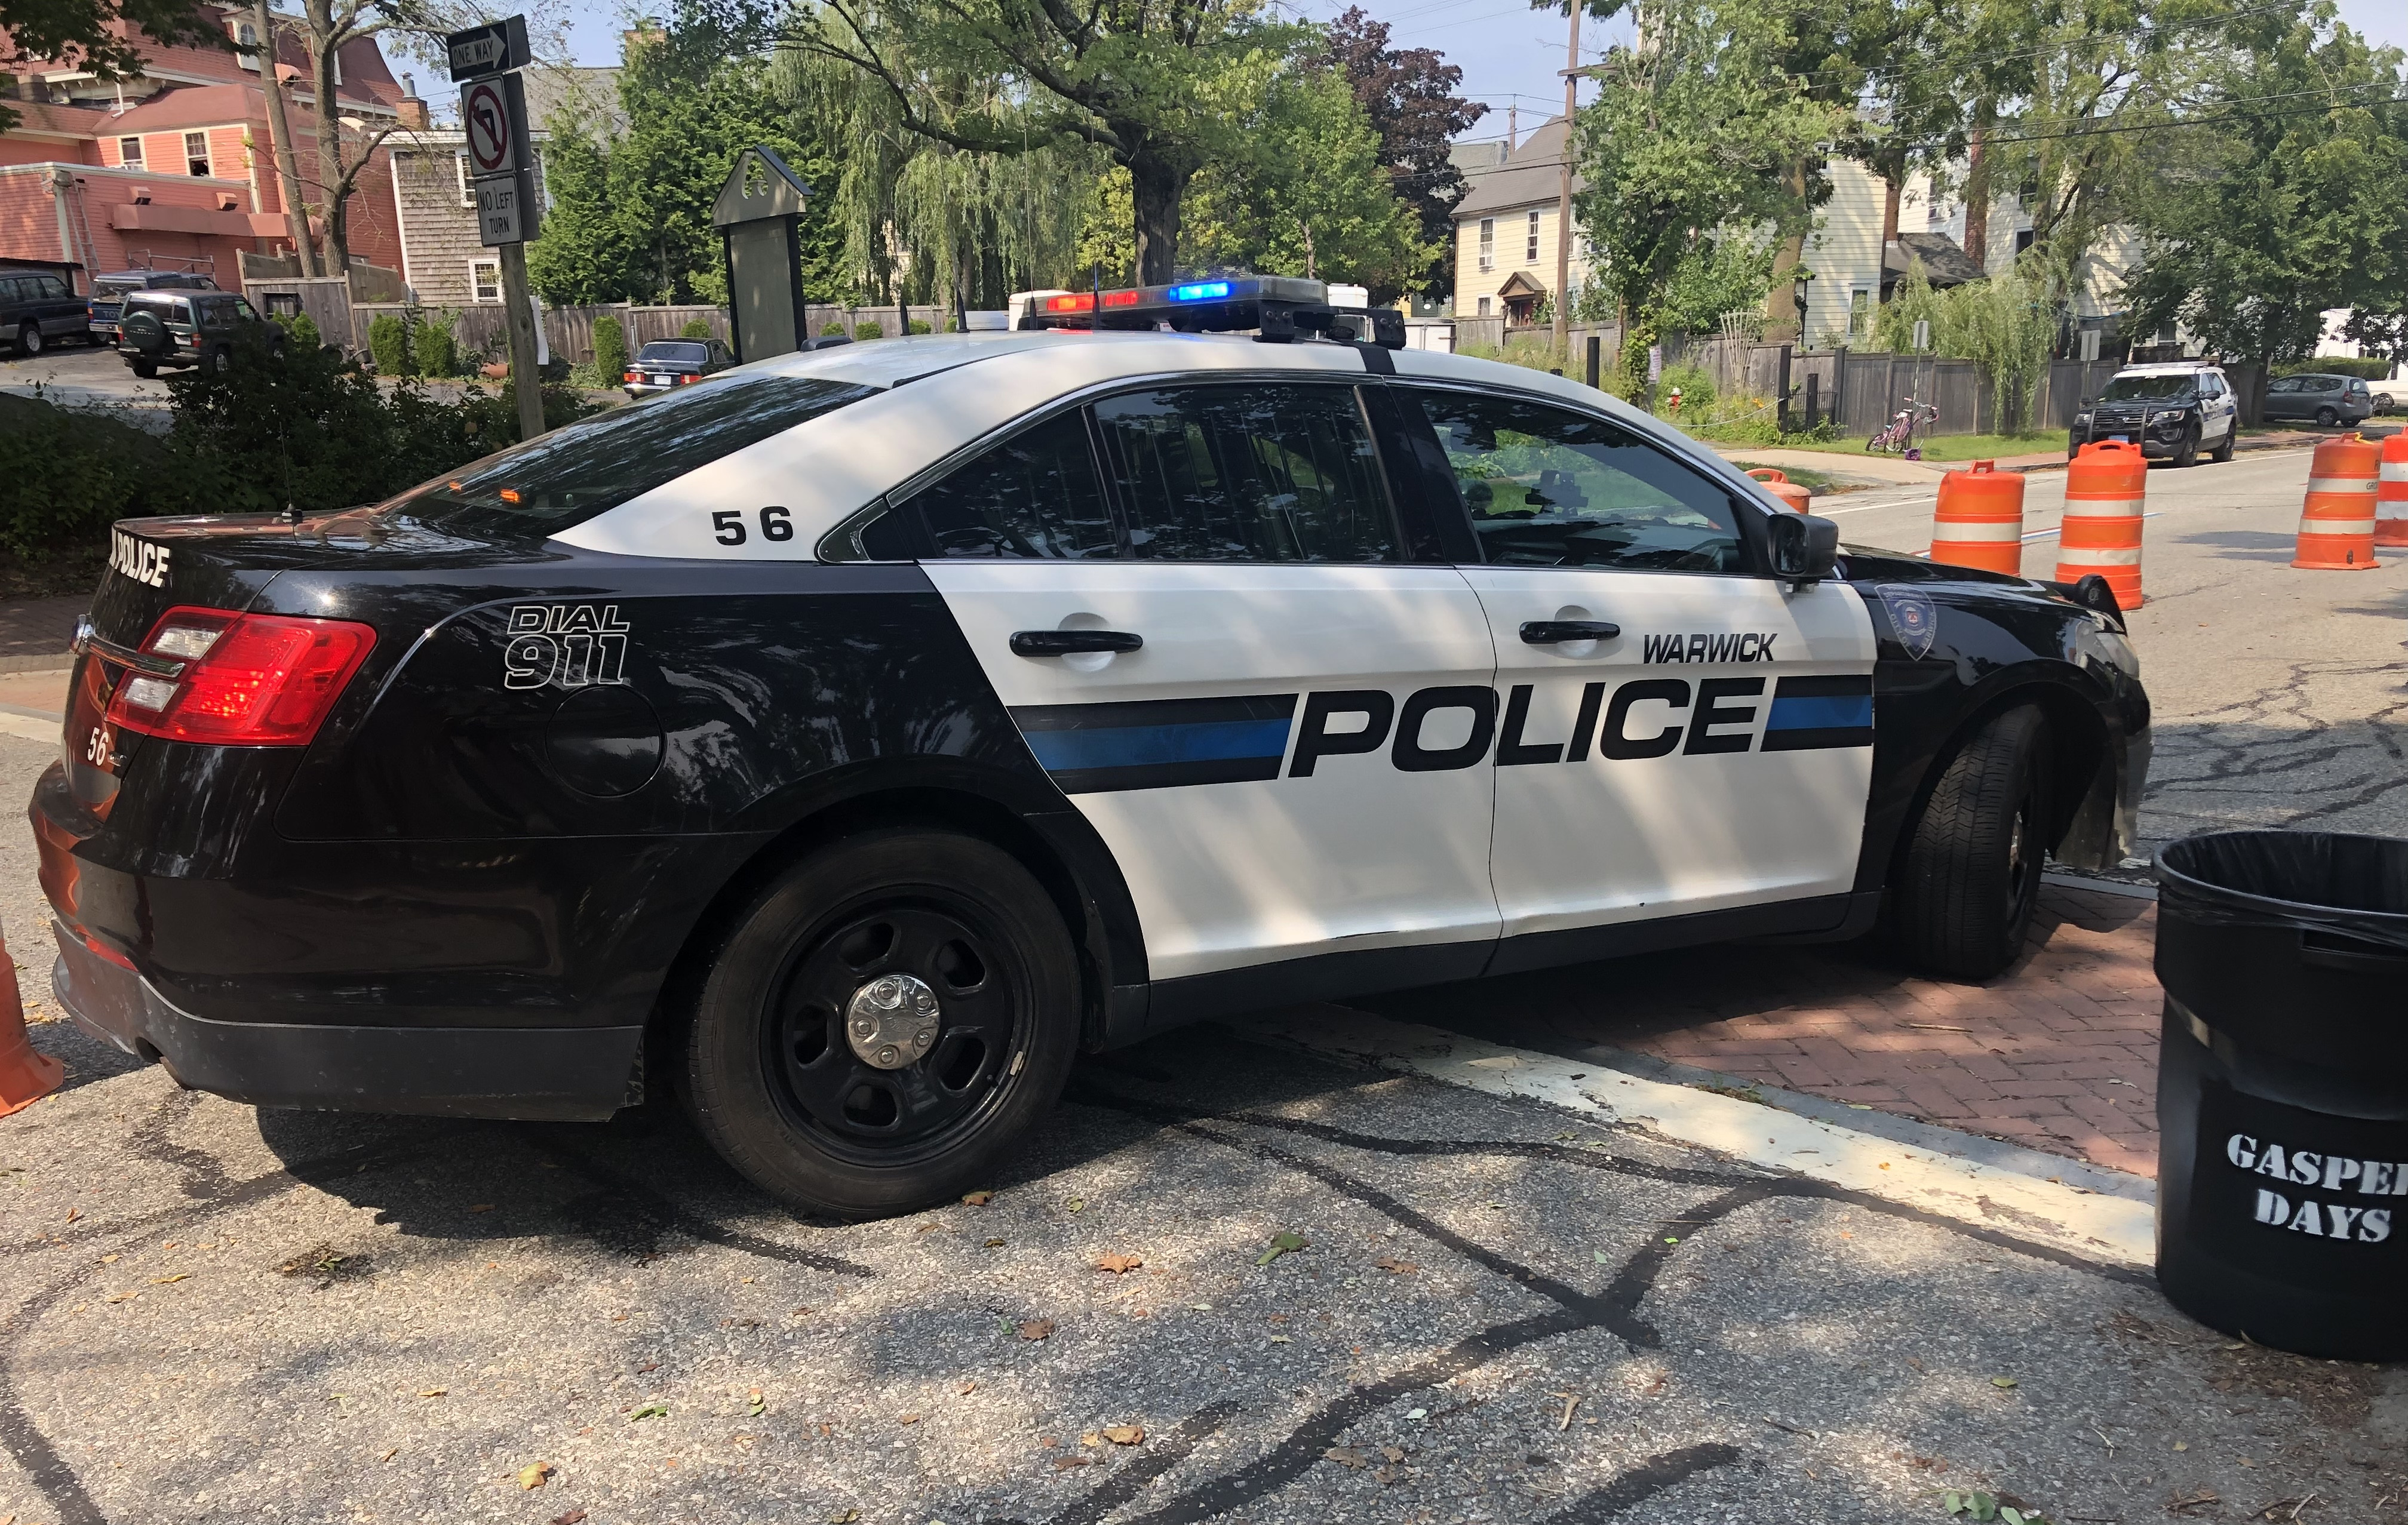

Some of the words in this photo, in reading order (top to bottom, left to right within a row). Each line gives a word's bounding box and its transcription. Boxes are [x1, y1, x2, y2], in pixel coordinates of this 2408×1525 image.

[453, 45, 471, 65] ONE
[474, 40, 493, 61] WAY
[479, 191, 493, 212] NO
[494, 191, 513, 210] LEFT
[489, 216, 509, 234] TURN
[114, 531, 170, 588] POLICE
[507, 605, 631, 635] DIAL
[504, 634, 628, 690] 911
[1643, 633, 1778, 665] WARWICK
[1288, 677, 1767, 779] POLICE
[87, 727, 109, 766] 56
[2255, 1188, 2392, 1243] DAYS
